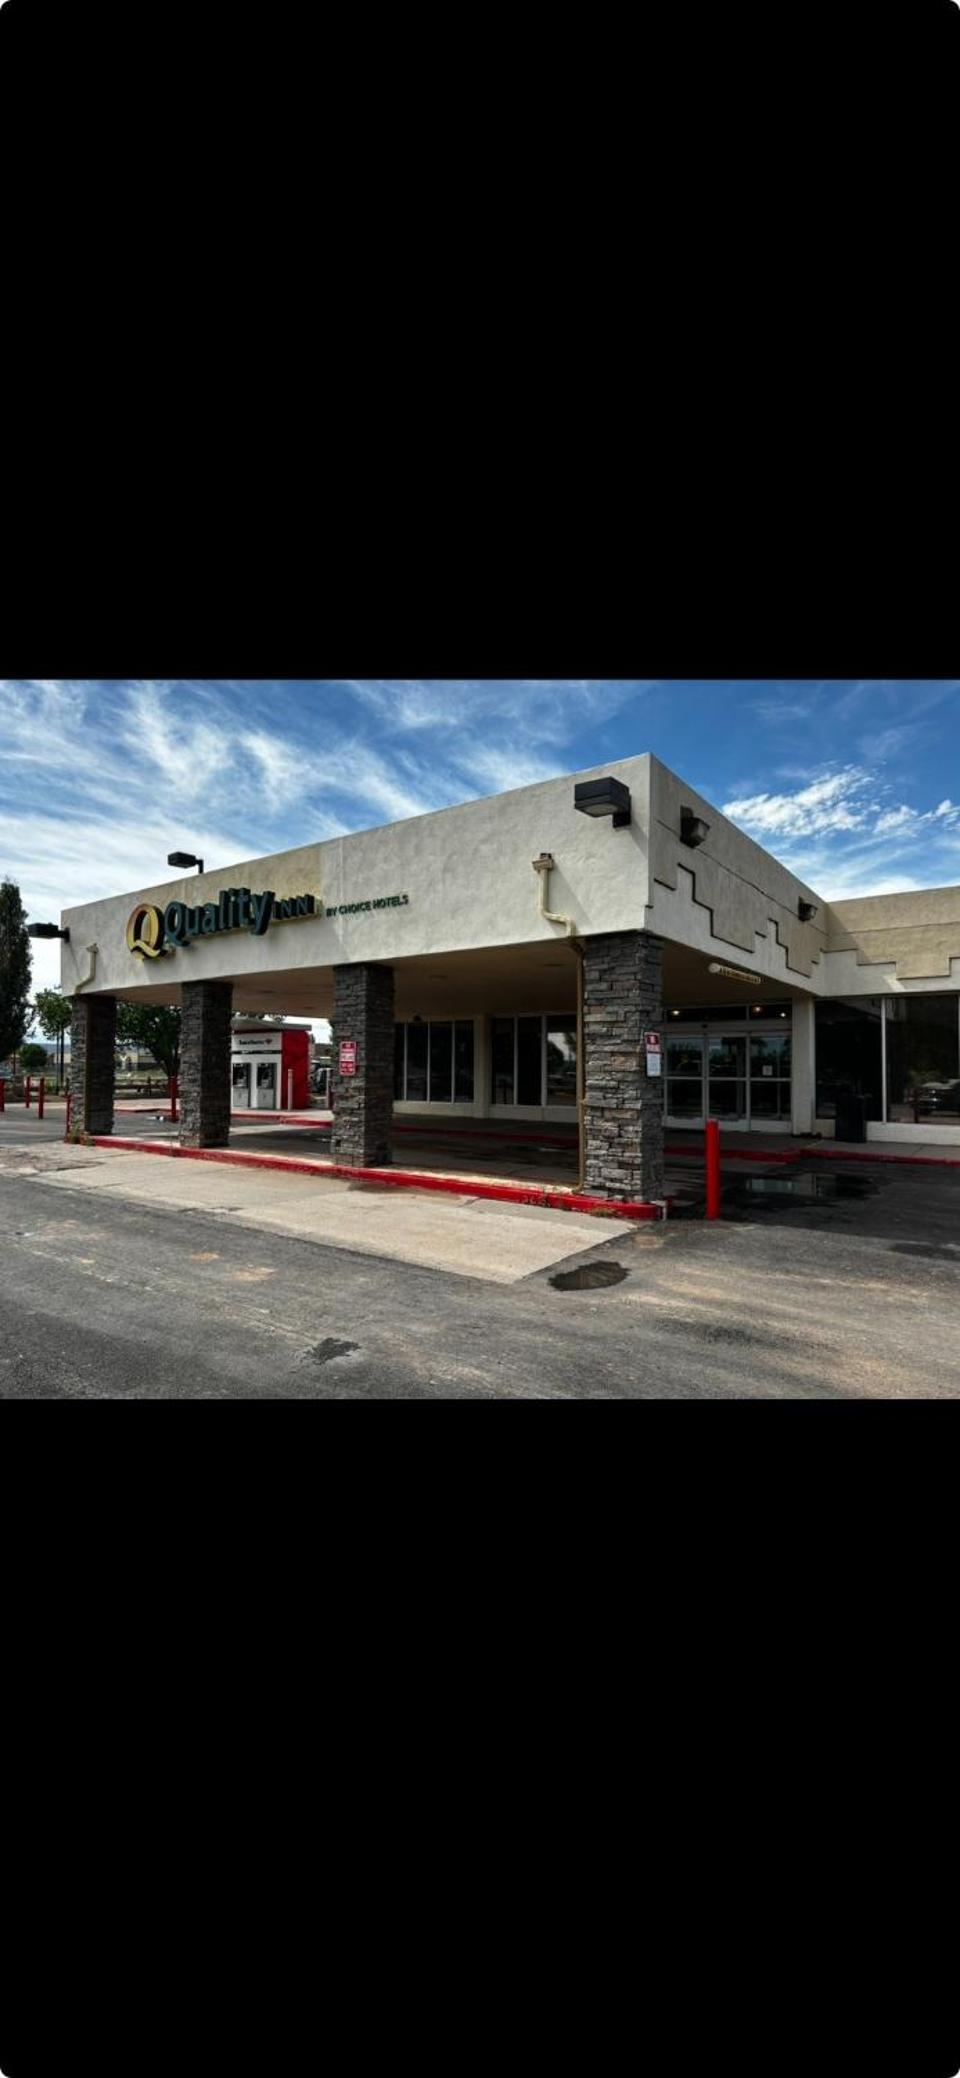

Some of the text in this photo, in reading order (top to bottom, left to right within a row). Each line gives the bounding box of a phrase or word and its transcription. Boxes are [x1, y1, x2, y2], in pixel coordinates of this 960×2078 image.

[164, 888, 315, 947] Quality INN
[326, 894, 409, 917] BY CHOICE HOTELS
